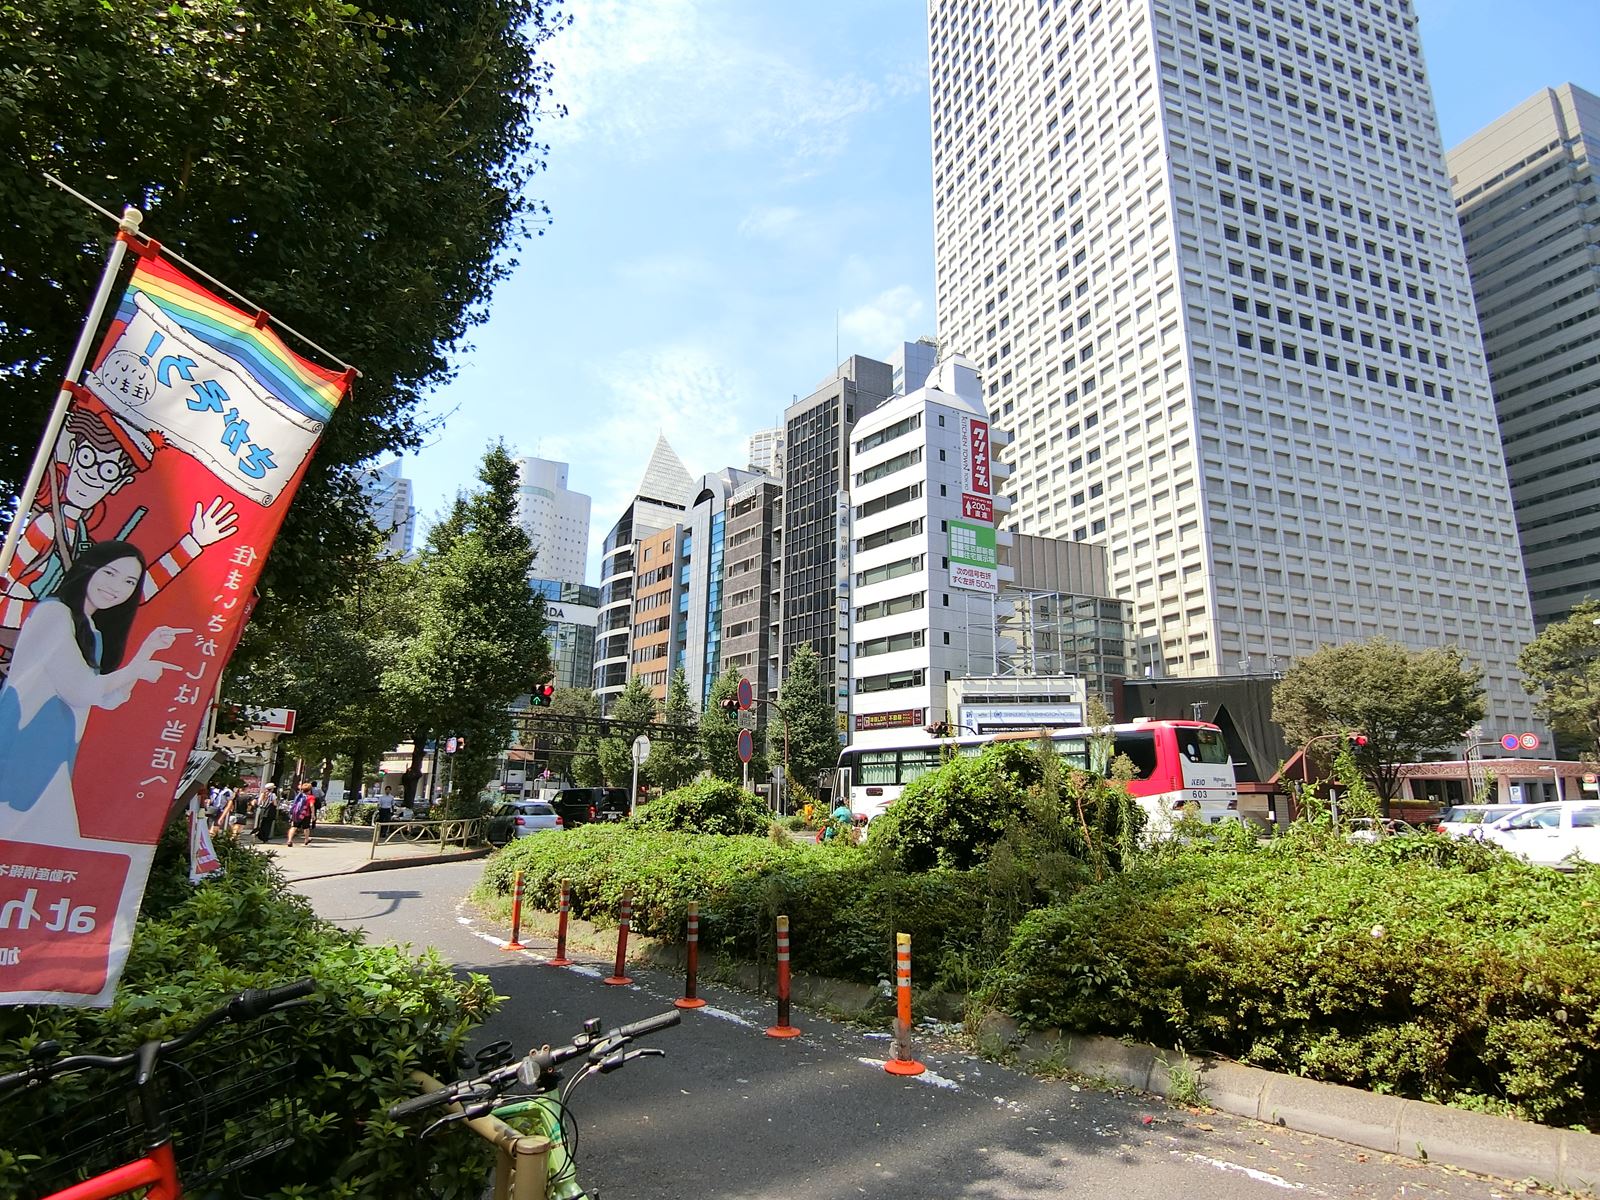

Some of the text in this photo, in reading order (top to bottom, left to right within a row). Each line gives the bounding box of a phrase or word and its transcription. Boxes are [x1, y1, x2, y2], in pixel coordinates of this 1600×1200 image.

[973, 427, 989, 488] クリナップ
[956, 567, 992, 580] 次の信号右折
[976, 579, 996, 590] 500m
[1192, 790, 1208, 799] 603
